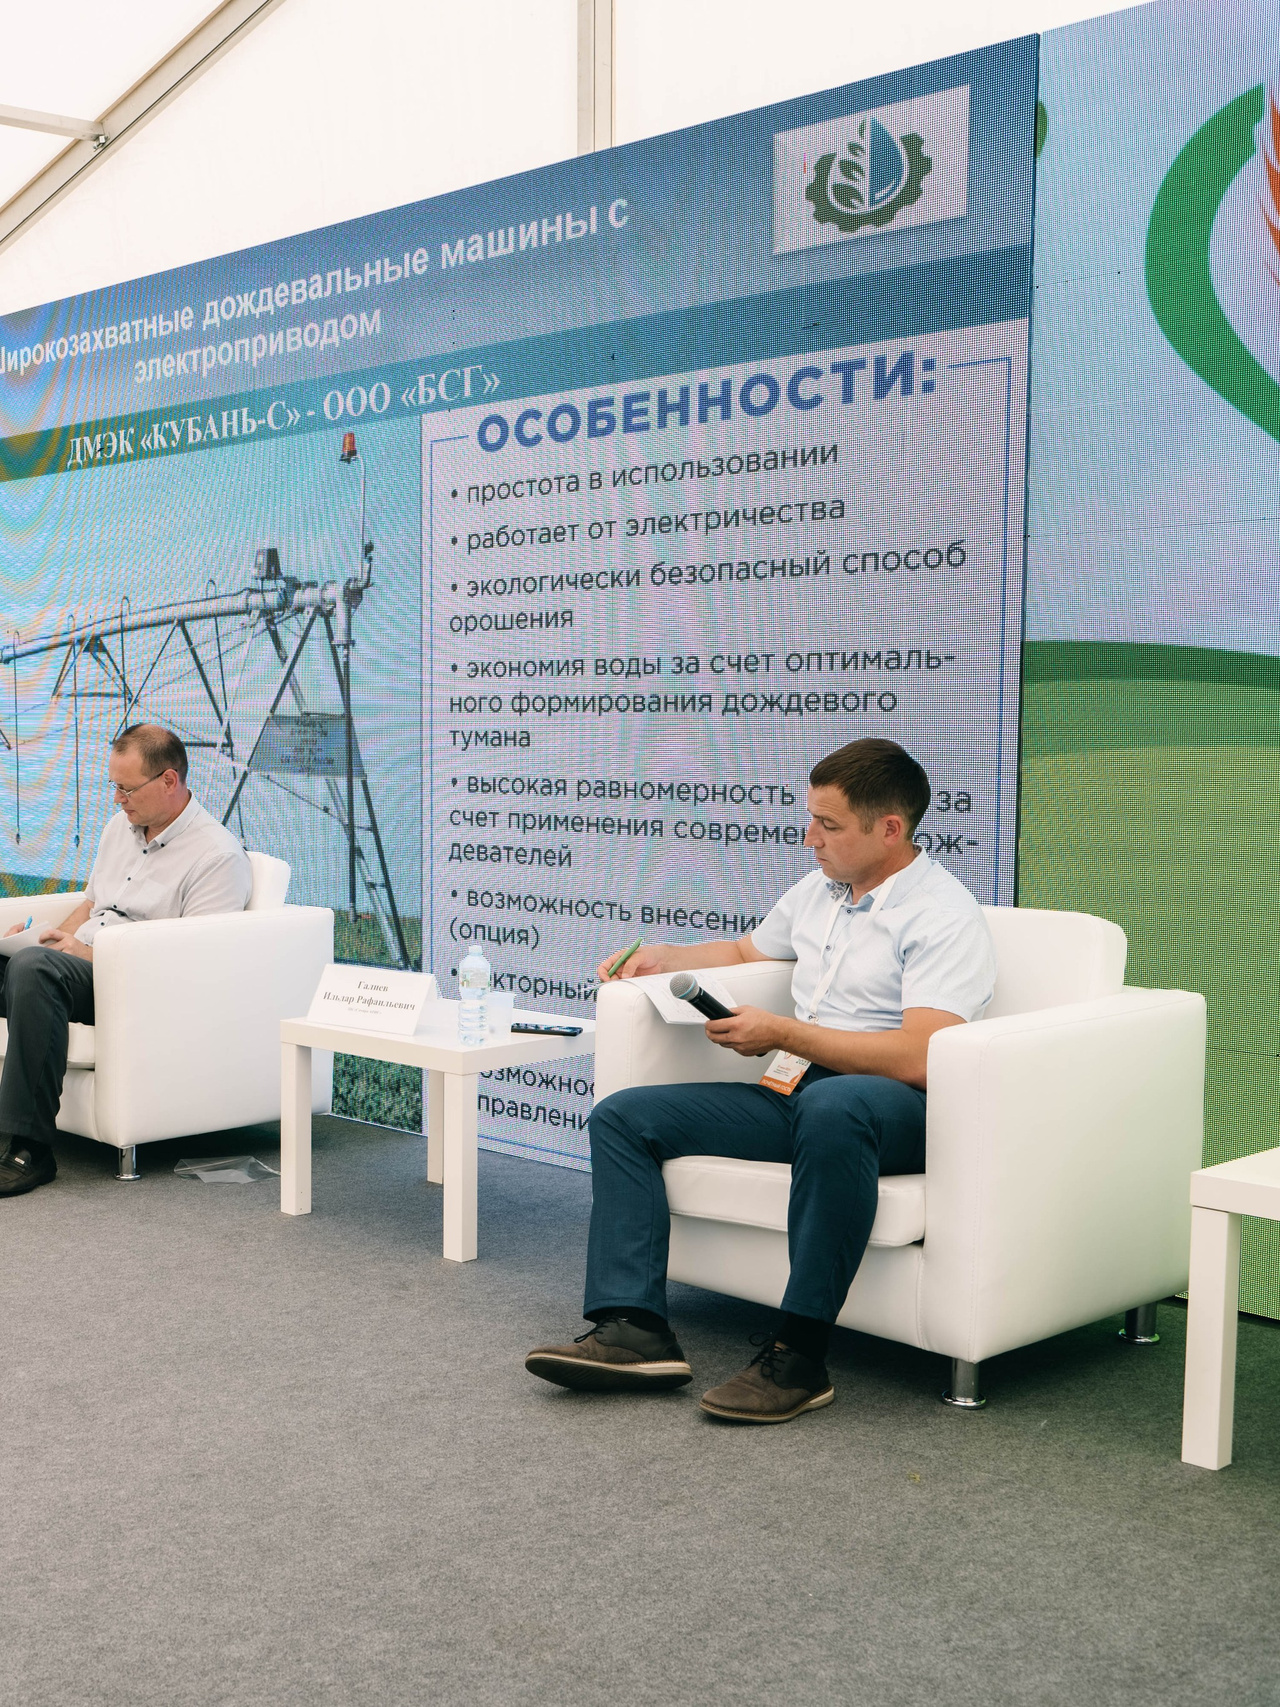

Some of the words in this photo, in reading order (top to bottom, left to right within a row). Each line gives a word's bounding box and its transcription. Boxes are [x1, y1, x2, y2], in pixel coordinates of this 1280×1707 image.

[203, 246, 428, 331] дождевальные
[439, 204, 599, 270] машины
[133, 309, 382, 385] электроприводом
[66, 427, 135, 469] ДМЭК
[139, 403, 301, 451] «КУБАНЬ-С»
[323, 381, 392, 422] ООО
[401, 367, 502, 409] «БСГ»
[477, 352, 937, 454] ОСОБЕННОСТИ:
[466, 473, 581, 505] простота
[589, 473, 603, 491] в
[612, 443, 839, 488] использовании
[466, 522, 579, 554] работает
[588, 519, 616, 540] от
[625, 498, 846, 538] электричества
[466, 569, 641, 598] экологически
[650, 549, 831, 588] безопасный
[841, 539, 967, 575] способ
[449, 609, 574, 636] орошения
[466, 656, 585, 679] экономия
[594, 654, 661, 680] воды
[671, 655, 700, 675] за
[709, 651, 775, 676] счет
[784, 646, 956, 673] оптималь-
[449, 694, 503, 713] ного
[511, 688, 712, 718] формирования
[721, 689, 898, 717] дождевого
[449, 729, 531, 753] тумана
[466, 774, 567, 797] высокая
[577, 776, 795, 808] равномерность
[936, 790, 972, 813] за
[449, 808, 500, 829] счет
[507, 809, 664, 840] применения
[449, 837, 572, 869] девателей
[466, 892, 632, 922] возможность
[449, 920, 540, 950] (опция)
